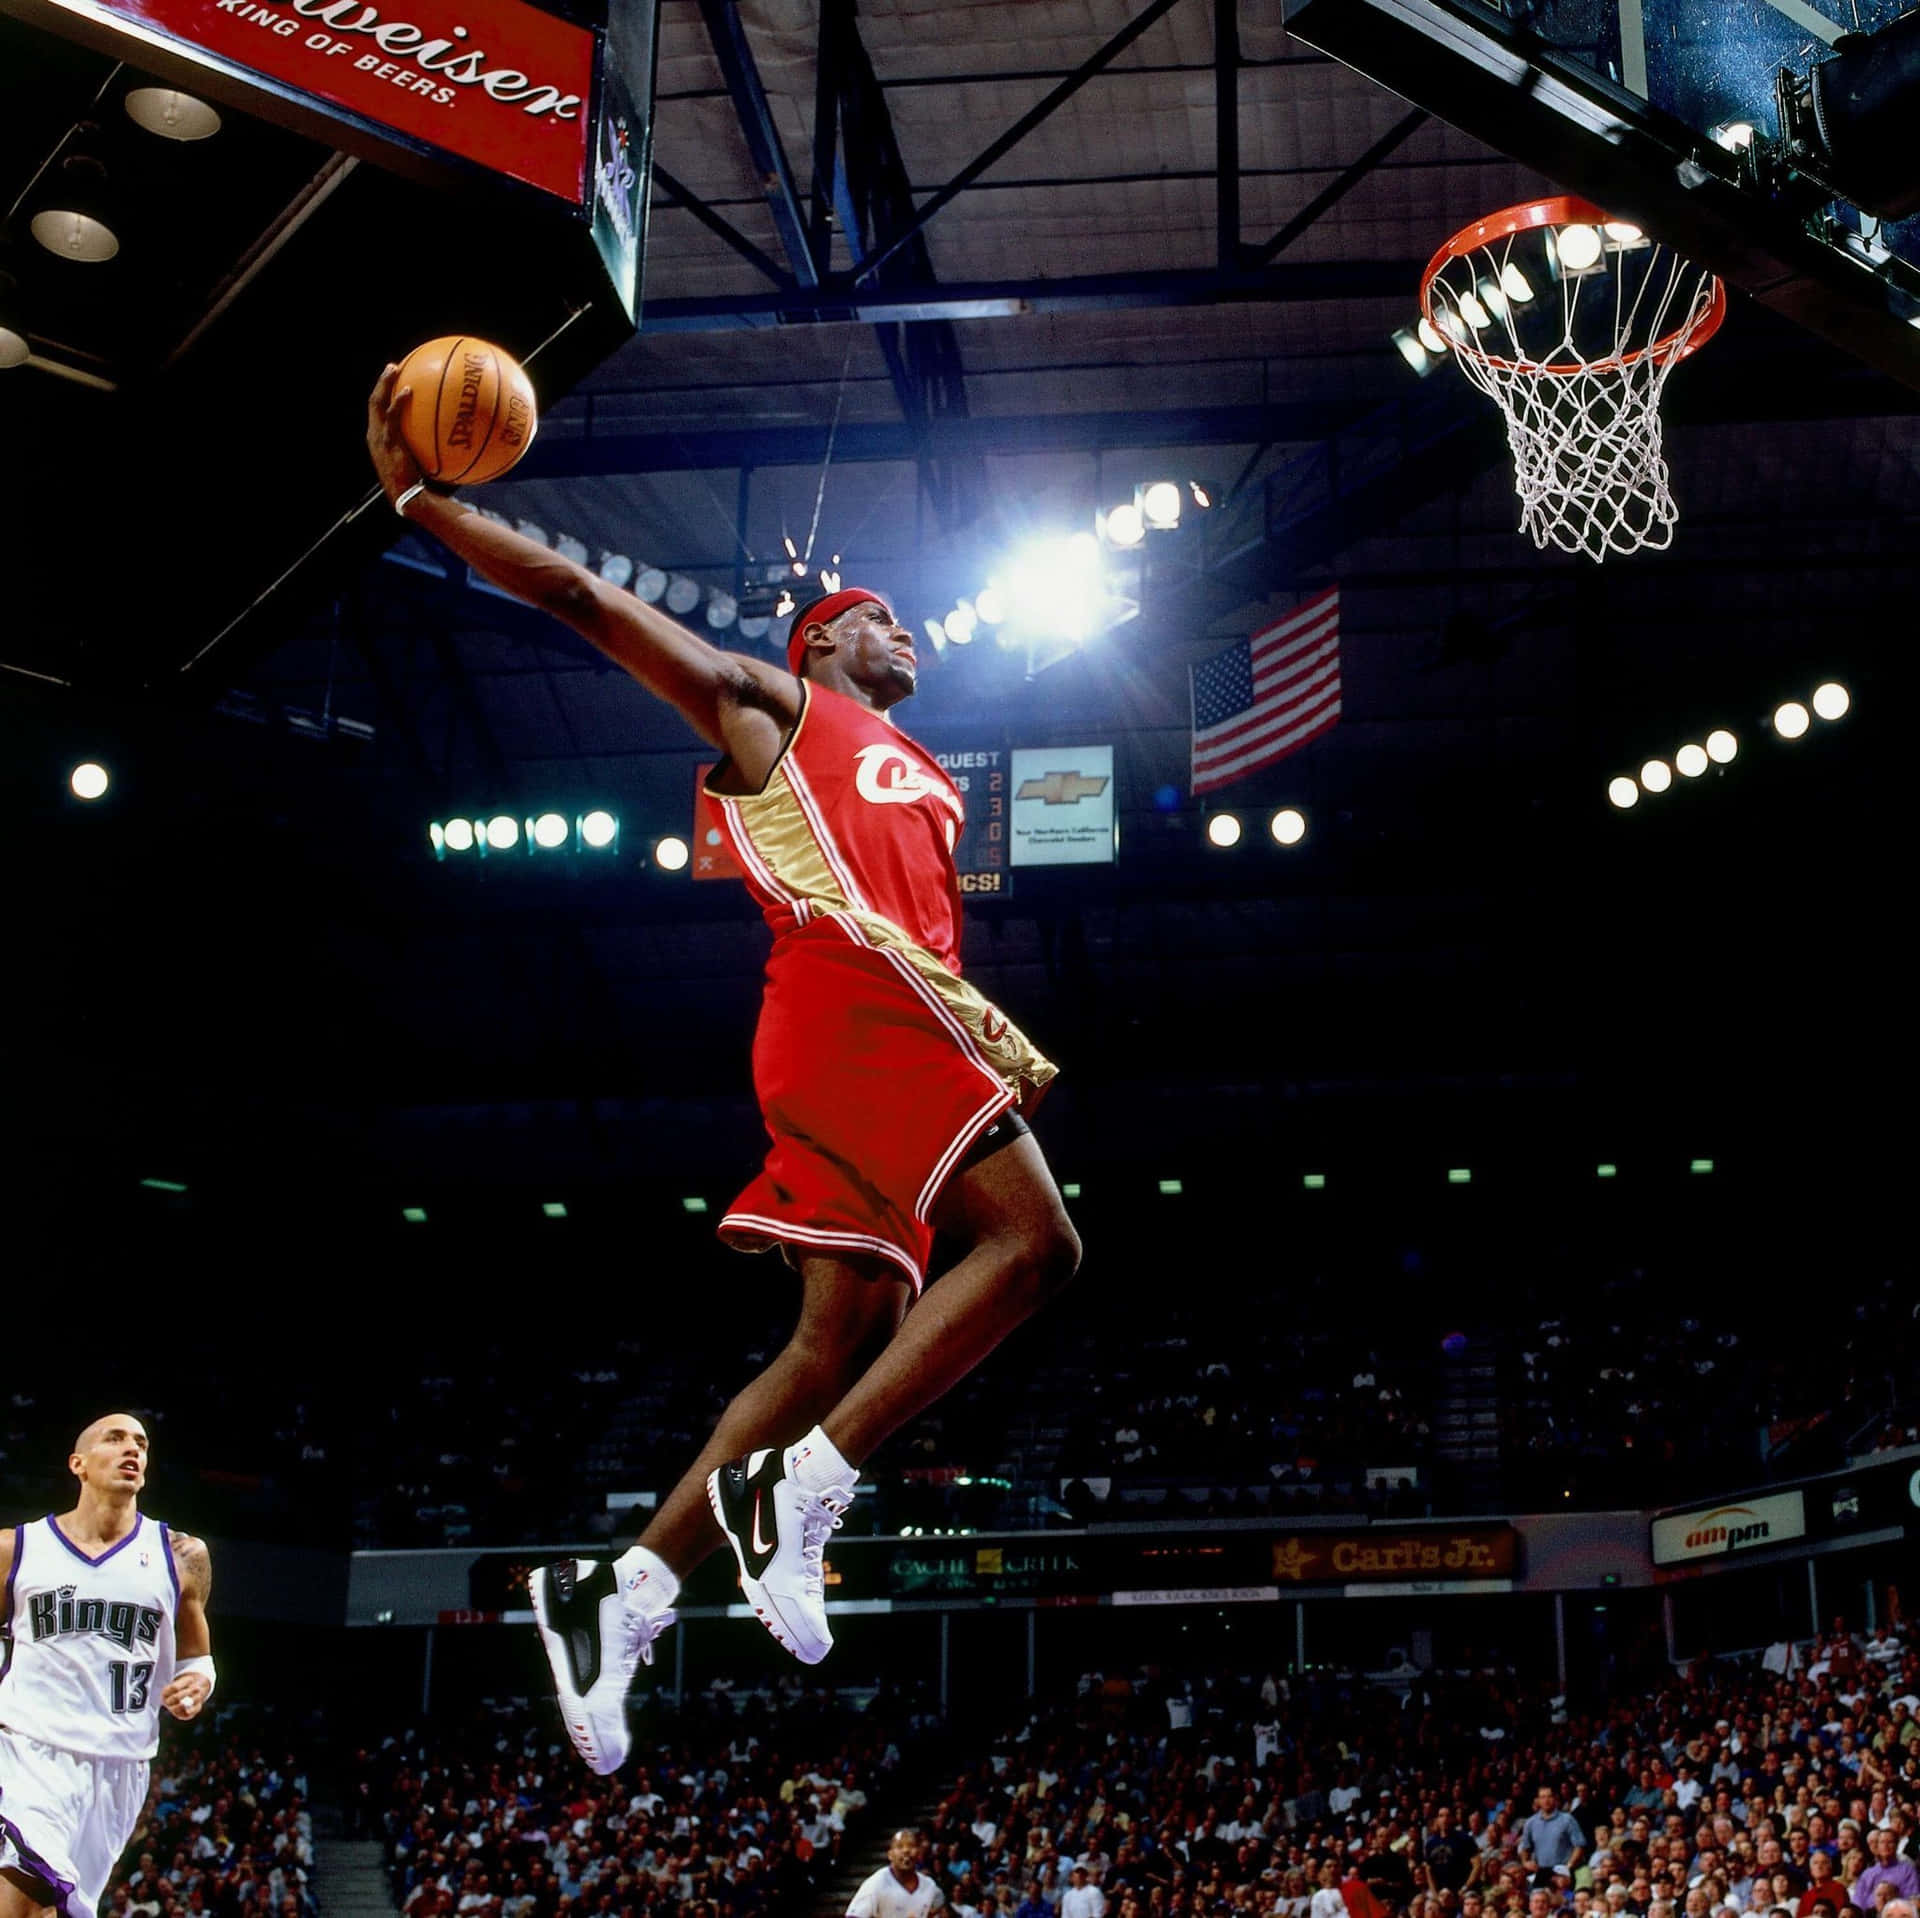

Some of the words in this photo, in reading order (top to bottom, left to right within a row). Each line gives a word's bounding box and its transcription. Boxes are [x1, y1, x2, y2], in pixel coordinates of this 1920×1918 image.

[216, 0, 300, 37] KING
[305, 33, 352, 56] OF
[449, 353, 487, 449] SPALDING
[937, 752, 1001, 769] GUEST
[1331, 1538, 1440, 1573] Carl's
[1444, 1535, 1497, 1569] Jr.
[1686, 1522, 1769, 1551] ampm
[27, 1584, 164, 1653] Kings
[108, 1660, 155, 1714] 13
